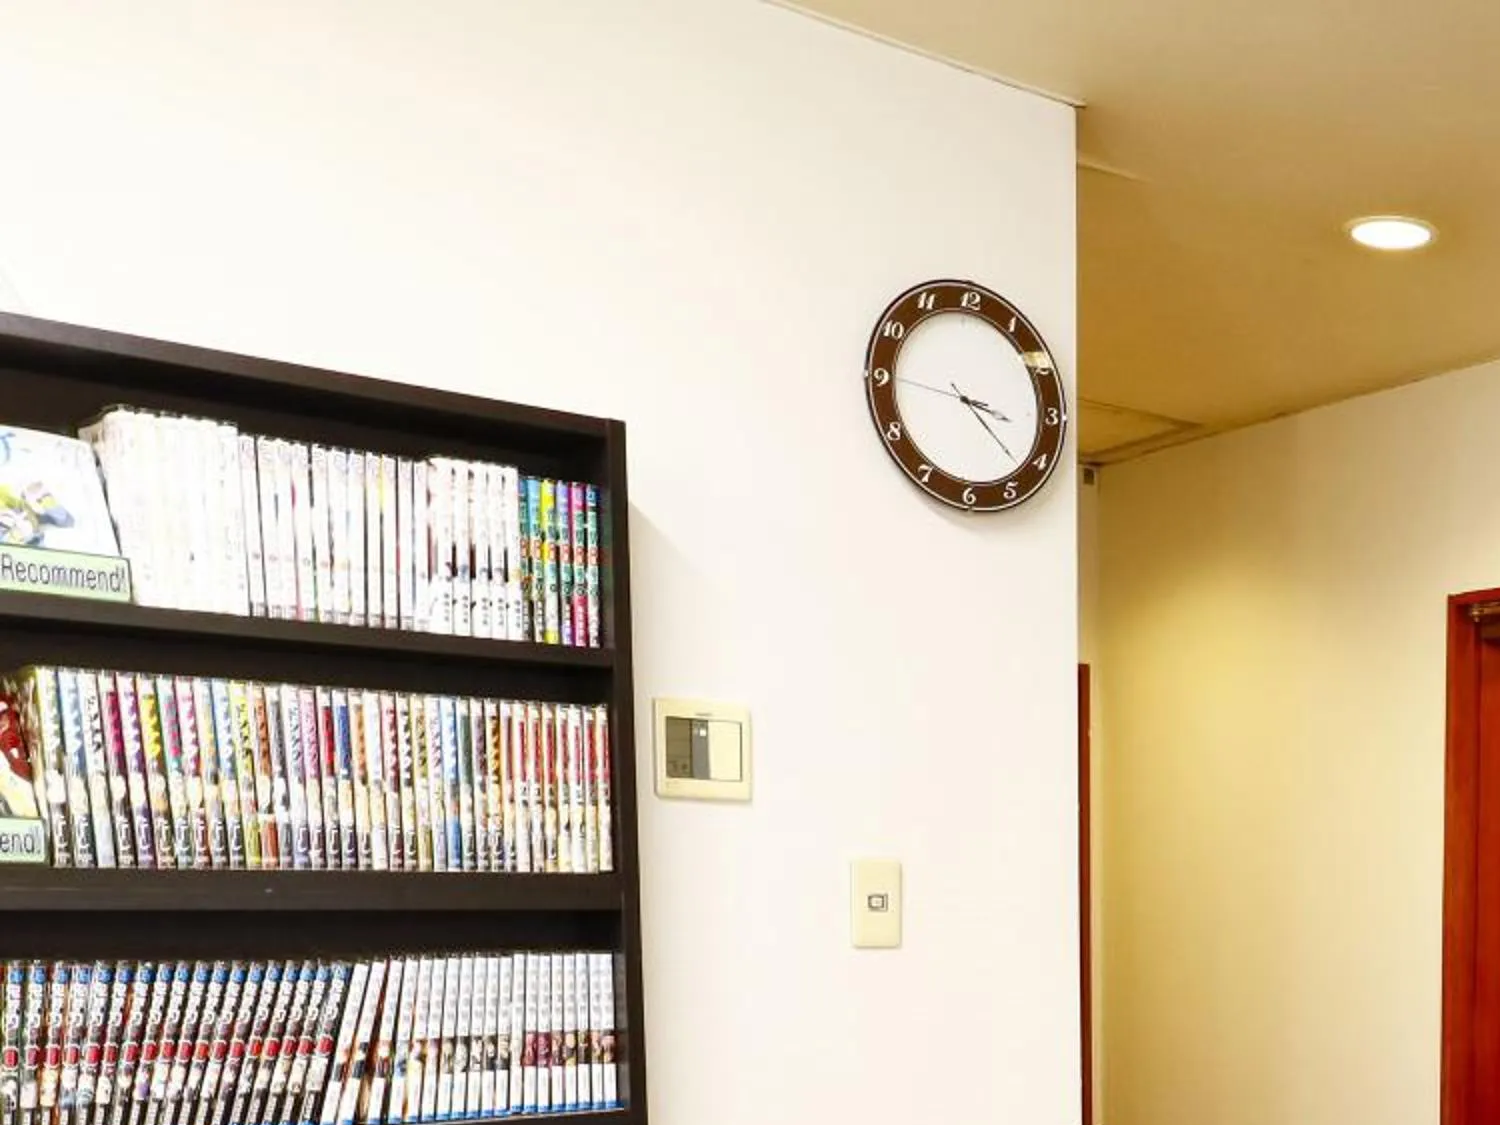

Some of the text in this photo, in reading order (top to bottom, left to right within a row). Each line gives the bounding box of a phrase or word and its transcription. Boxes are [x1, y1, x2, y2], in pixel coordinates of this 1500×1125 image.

[918, 291, 936, 310] 11
[960, 291, 982, 311] 12
[882, 319, 904, 340] 10
[1007, 315, 1017, 333] 1
[873, 367, 890, 387] 9
[1045, 407, 1059, 426] 3
[887, 421, 901, 440] 8
[1033, 453, 1048, 471] 4
[918, 465, 934, 483] 7
[962, 487, 977, 505] 6
[1003, 481, 1019, 499] 5
[1, 552, 127, 593] Recommend!
